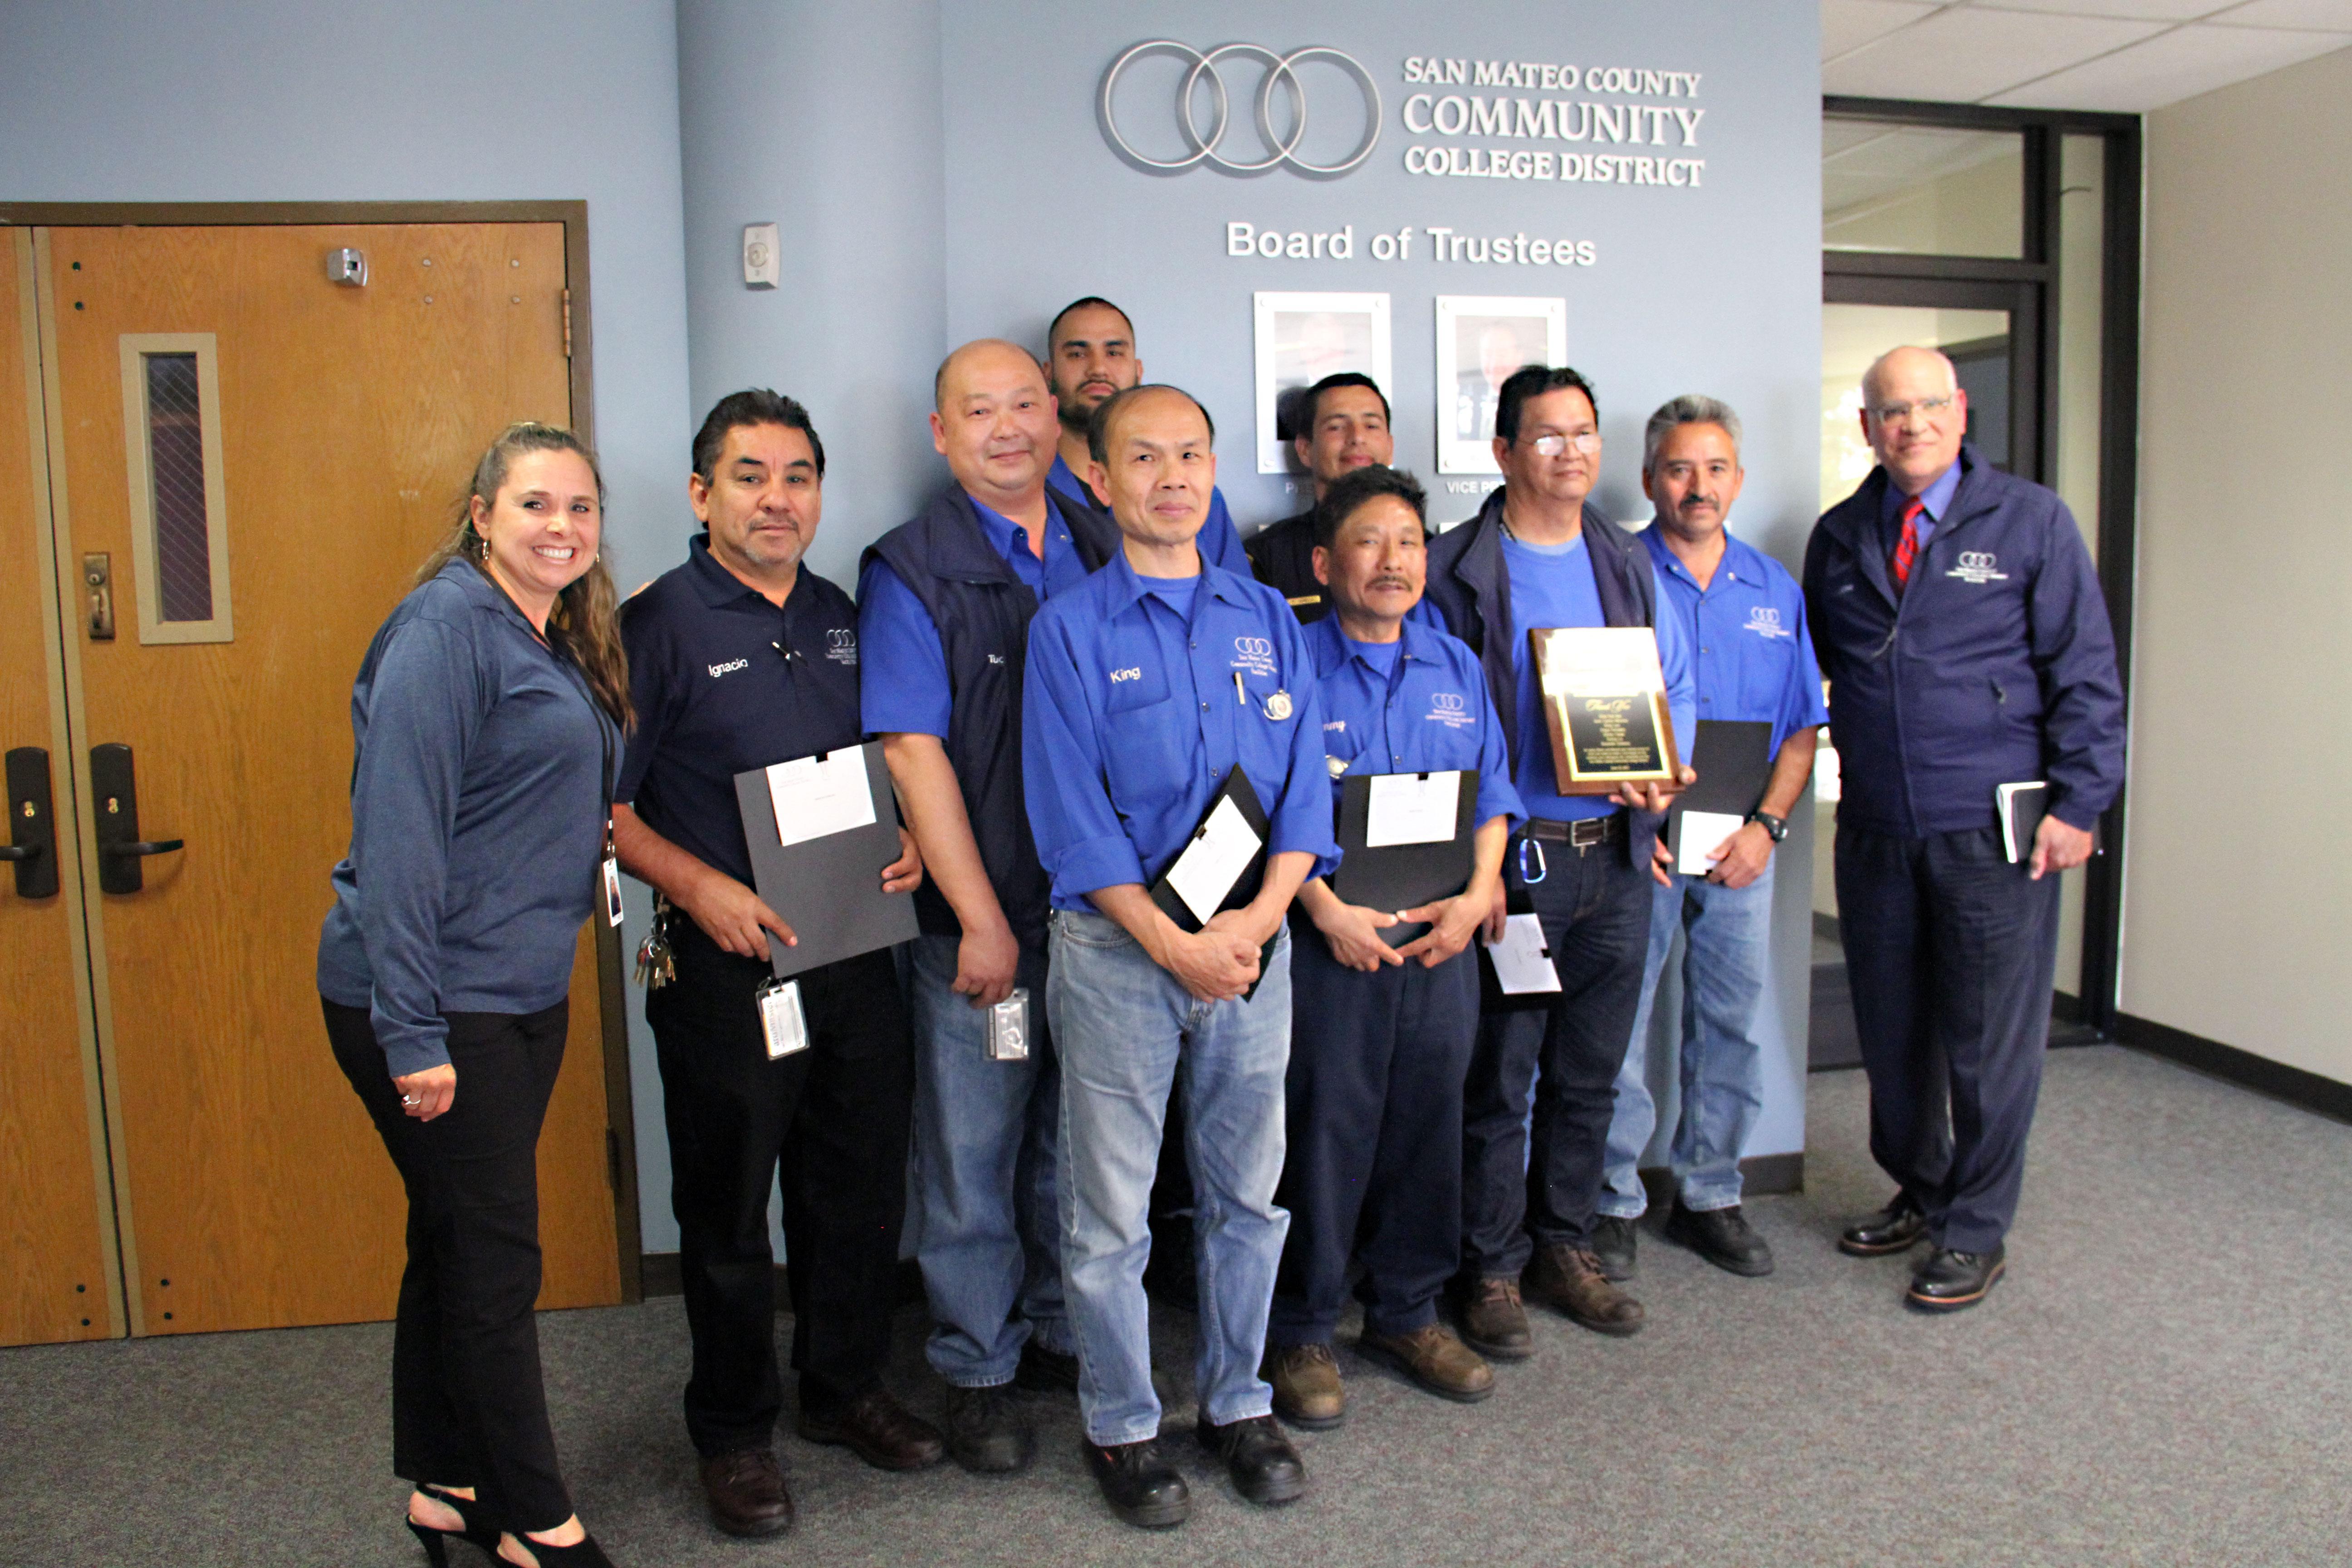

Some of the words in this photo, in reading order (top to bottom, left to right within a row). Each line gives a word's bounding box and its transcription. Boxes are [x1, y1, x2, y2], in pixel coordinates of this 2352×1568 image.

[1404, 56, 1467, 85] SAN
[1473, 60, 1580, 90] MATEO
[1585, 66, 1702, 98] COUNTY
[1403, 93, 1706, 147] COMMUNITY
[1404, 145, 1554, 180] COLLEGE
[1559, 152, 1706, 187] DISTRICT
[1227, 220, 1353, 260] Board
[1371, 226, 1412, 260] of
[1426, 226, 1597, 266] Trustees
[1446, 481, 1478, 494] VICE
[708, 658, 748, 677] Ignacio
[1110, 666, 1141, 683] King
